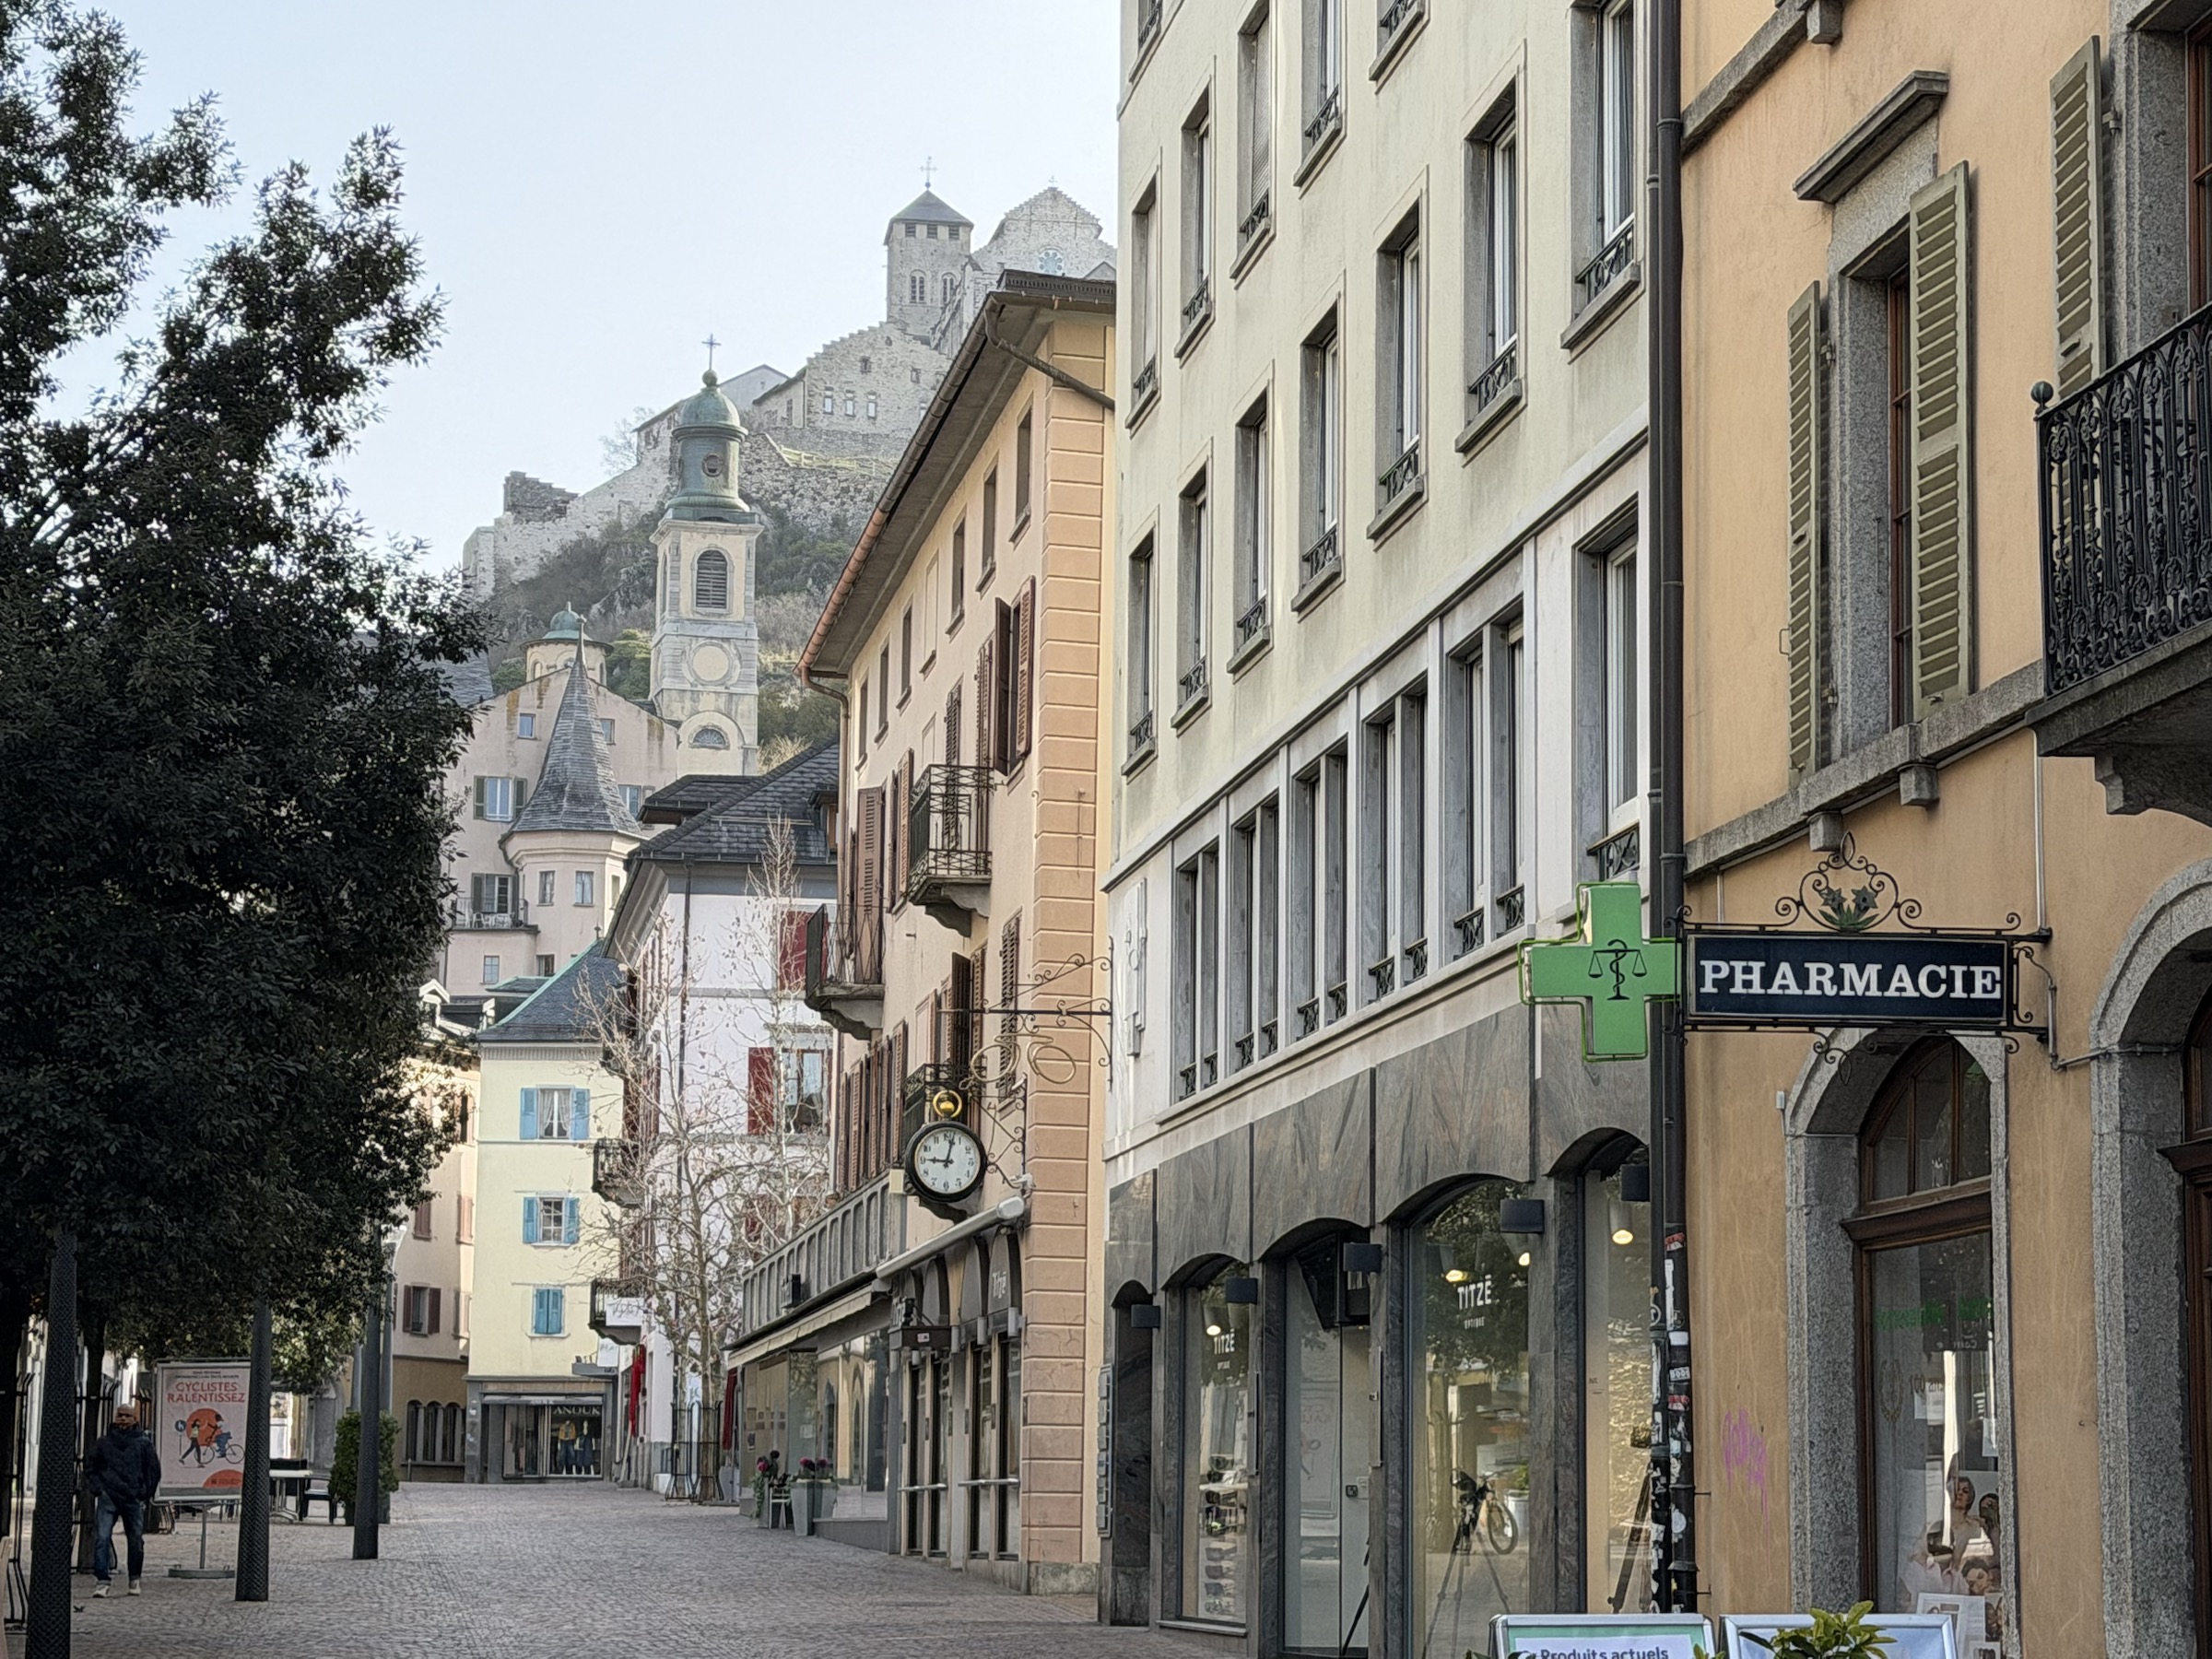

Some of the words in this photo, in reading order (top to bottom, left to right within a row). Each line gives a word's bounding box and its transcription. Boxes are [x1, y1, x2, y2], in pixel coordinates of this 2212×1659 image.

[1700, 959, 2002, 1000] PHARMACIE
[1457, 1274, 1492, 1310] TITZÉ
[175, 1382, 238, 1392] CYCLISTES
[167, 1393, 245, 1403] RALENTISSEZ
[553, 1406, 600, 1415] ANOUK
[1540, 1648, 1606, 1659] Produits
[1611, 1646, 1669, 1659] actuels
